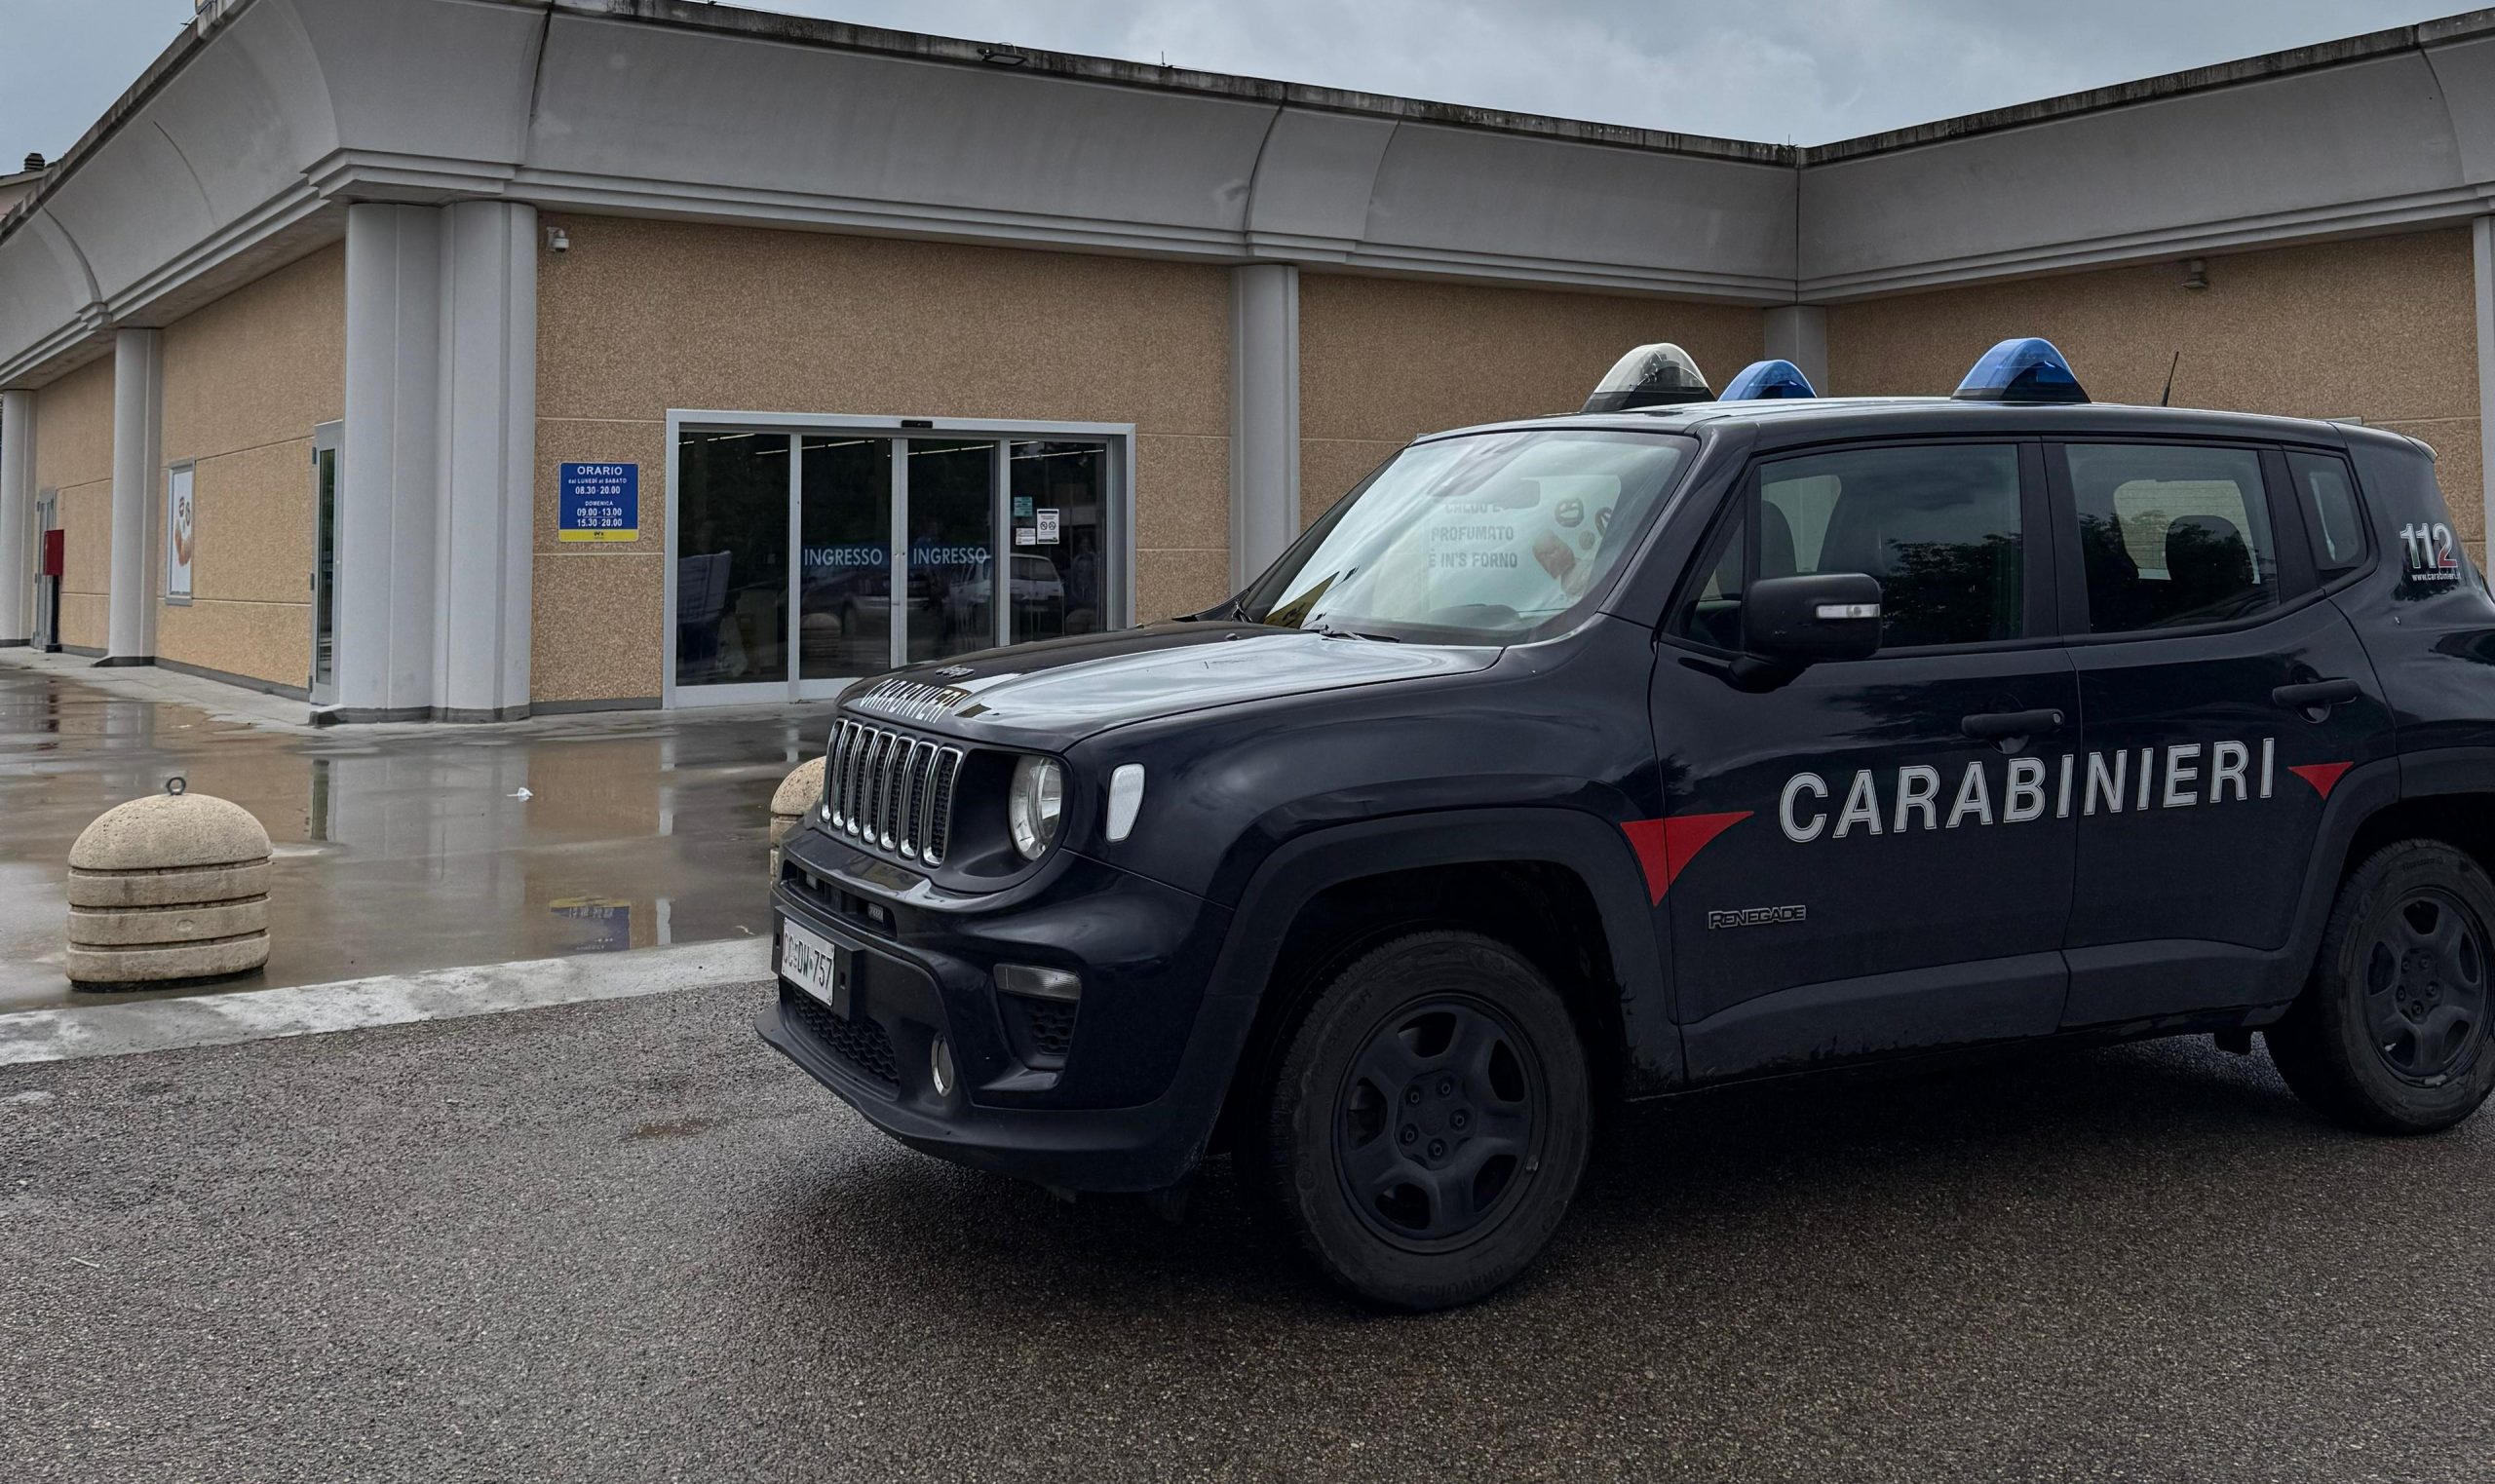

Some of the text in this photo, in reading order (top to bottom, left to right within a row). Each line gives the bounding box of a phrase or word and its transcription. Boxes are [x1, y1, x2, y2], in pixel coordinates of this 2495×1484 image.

[577, 466, 623, 476] ORARIO
[575, 485, 595, 495] 08.30
[600, 485, 621, 495] 20.00
[577, 508, 597, 516] 09.00
[602, 508, 622, 516] 13.00
[577, 518, 597, 527] 15.30
[601, 518, 623, 527] 20.00
[1431, 525, 1514, 542] PROFUMATO
[2399, 522, 2458, 569] 112
[804, 549, 883, 566] INGRESSO
[913, 547, 987, 565] INGRESSO
[1472, 552, 1517, 568] FORNO
[860, 678, 968, 724] CARABINIERI
[1780, 738, 2275, 843] CARABINIERI
